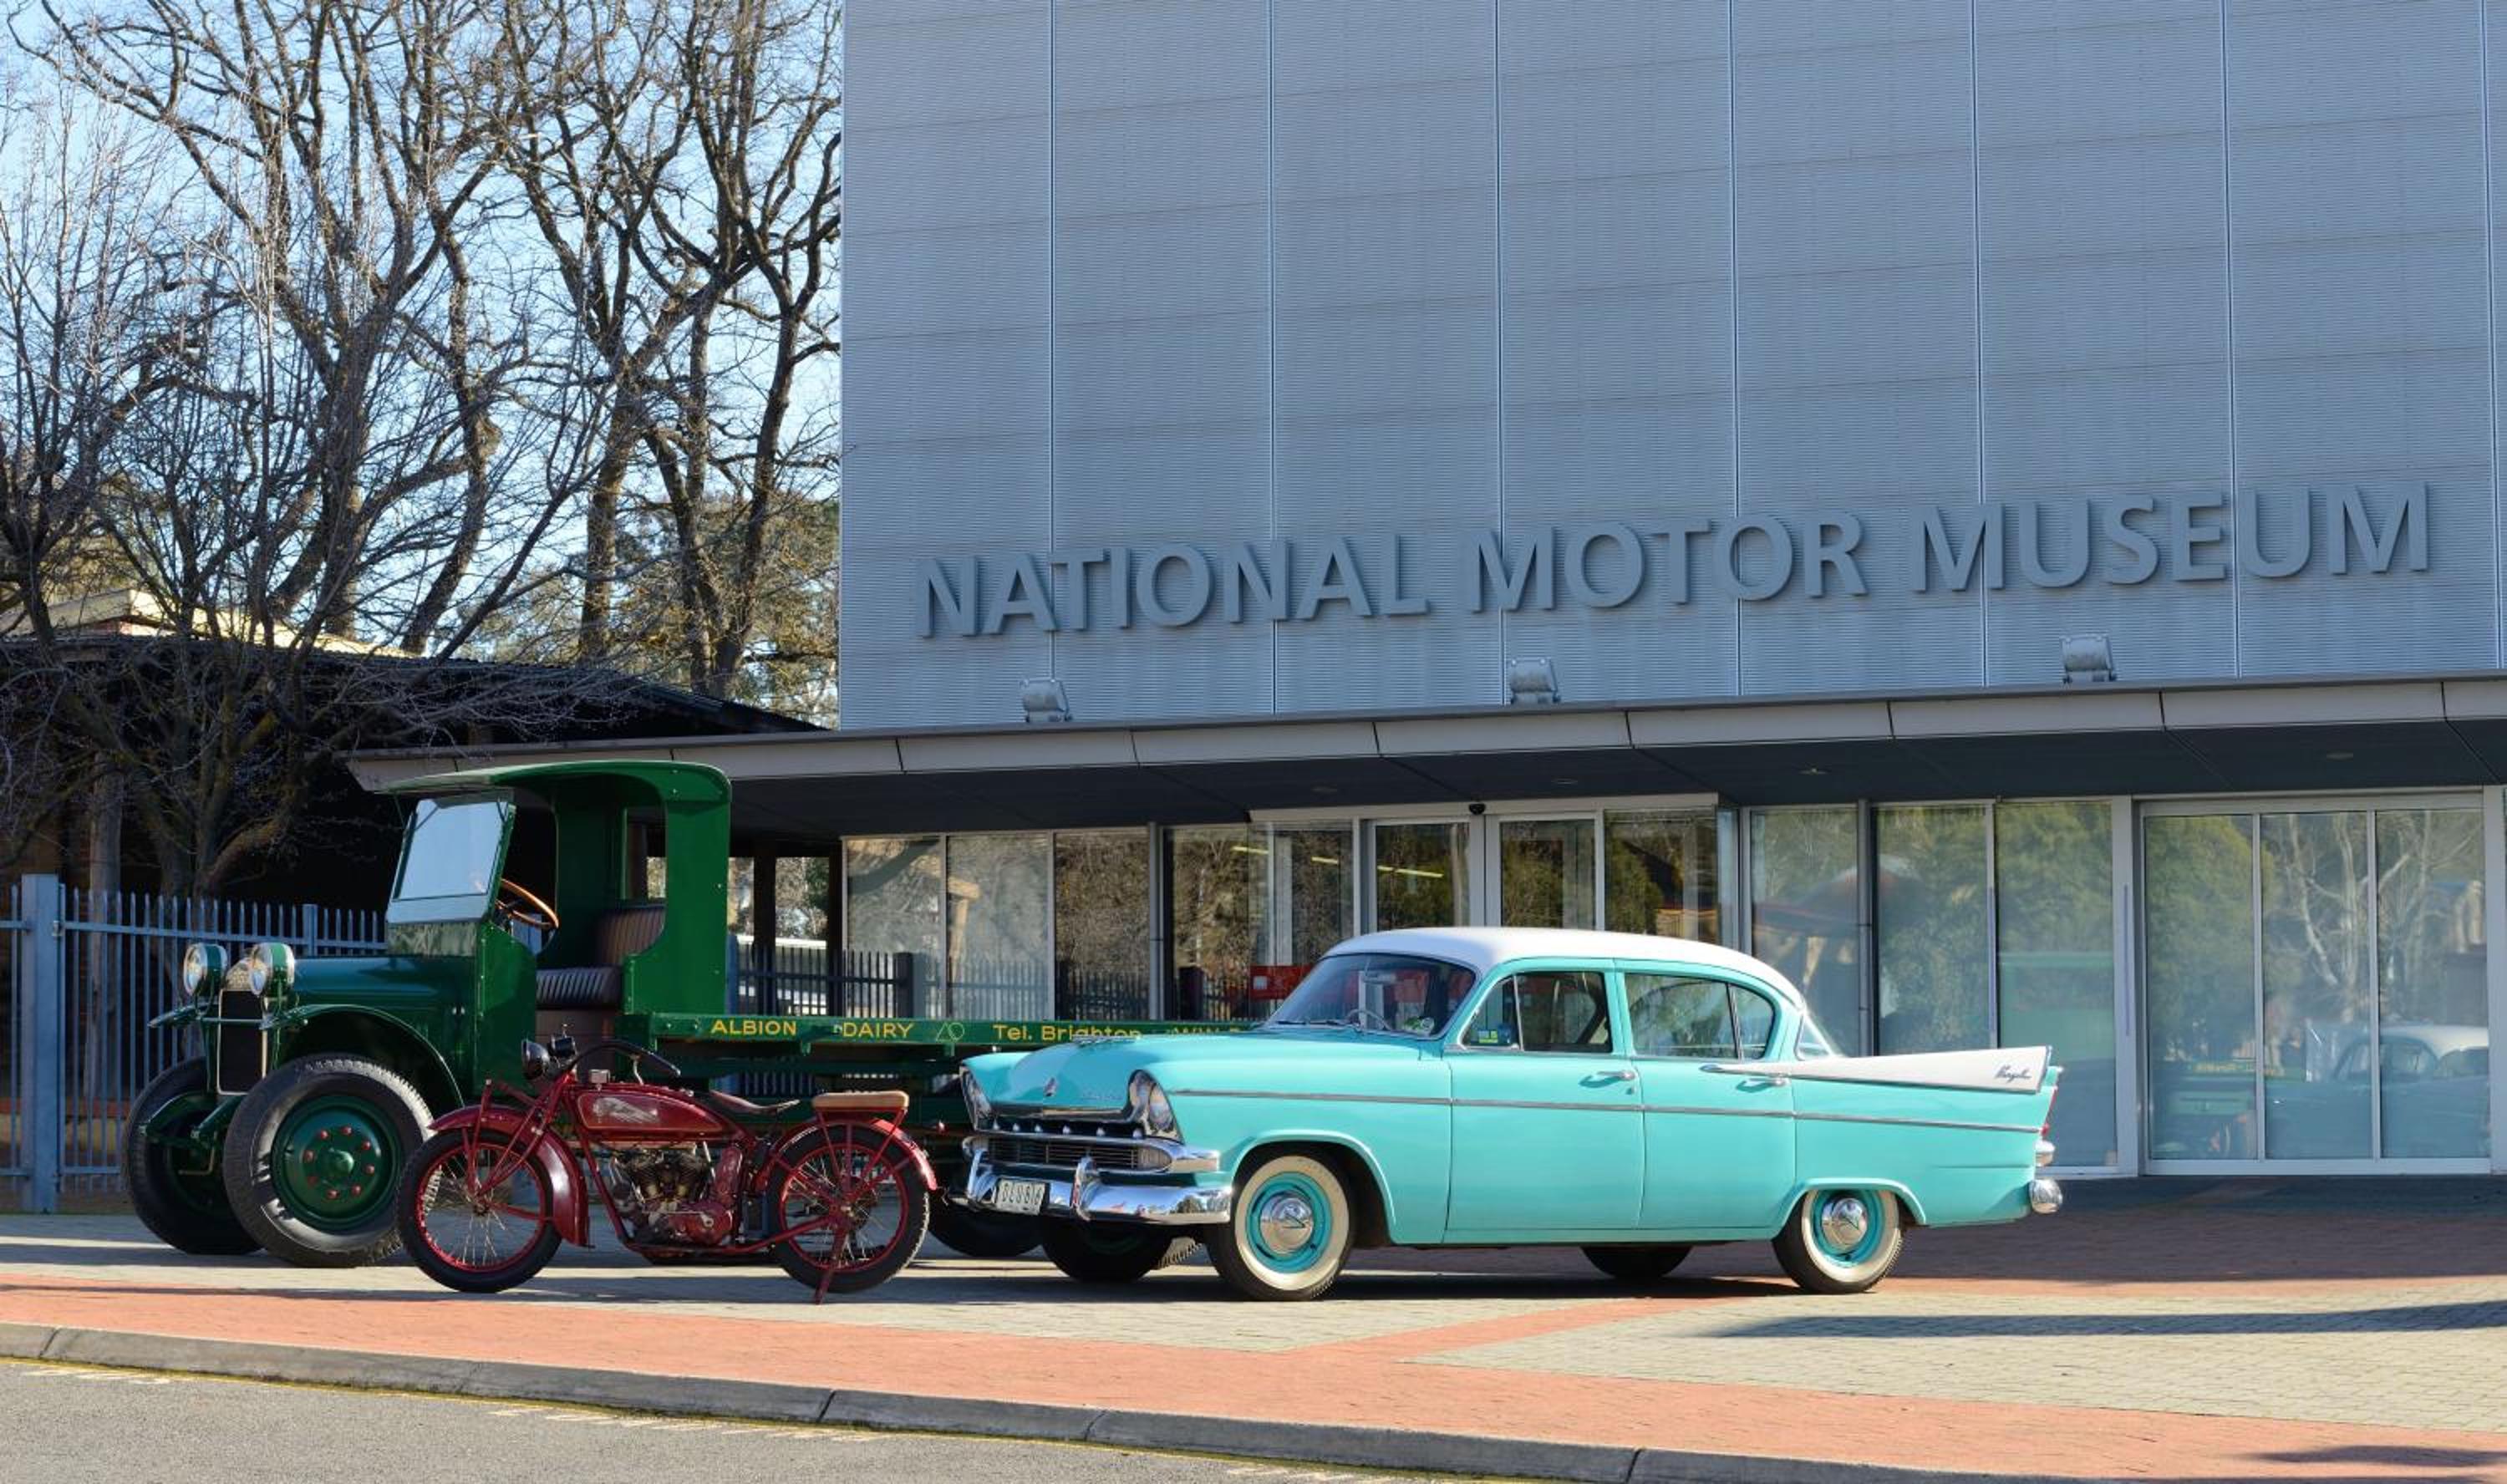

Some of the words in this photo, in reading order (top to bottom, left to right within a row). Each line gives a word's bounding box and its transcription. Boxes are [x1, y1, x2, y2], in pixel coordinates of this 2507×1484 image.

[916, 533, 1429, 638] NATIONAL
[1467, 511, 1869, 613] MOTOR
[1911, 481, 2430, 592] MUSEUM
[710, 1020, 796, 1035] ALBION
[842, 1022, 914, 1038] DAIRY
[993, 1024, 1032, 1040] Tel.
